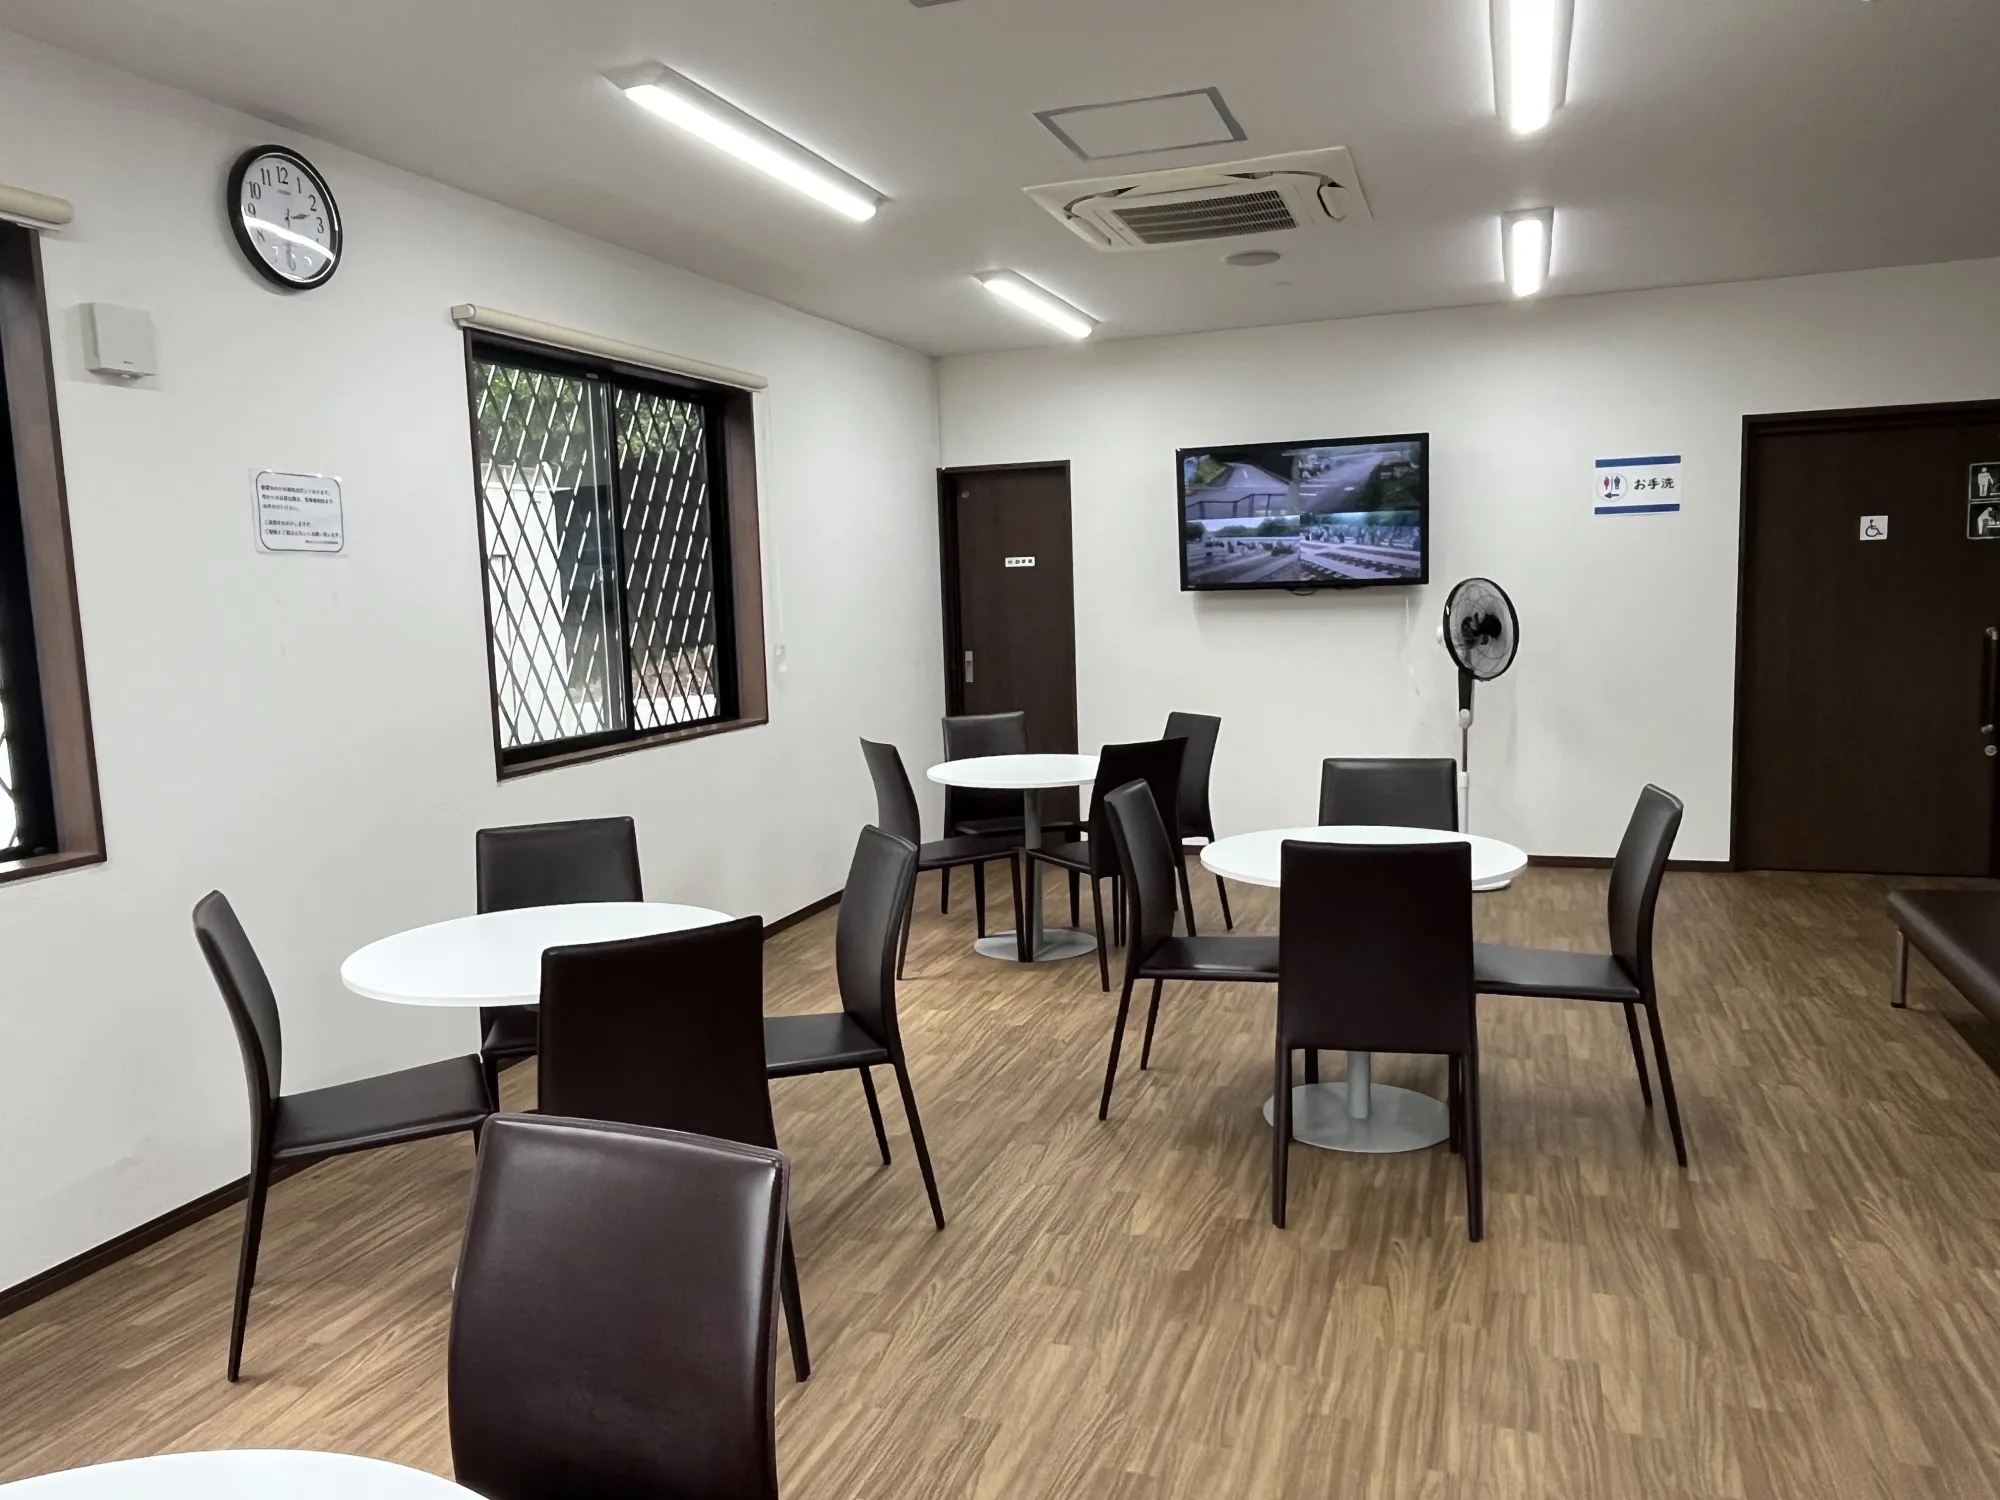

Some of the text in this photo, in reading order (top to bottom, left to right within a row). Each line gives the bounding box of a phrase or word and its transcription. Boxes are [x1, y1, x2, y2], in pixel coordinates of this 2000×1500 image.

[261, 168, 272, 187] 11
[276, 166, 289, 184] 12
[249, 181, 261, 200] 10
[296, 177, 302, 193] 1
[308, 194, 317, 212] 2
[316, 217, 324, 234] 3
[1633, 477, 1675, 490] お手洗
